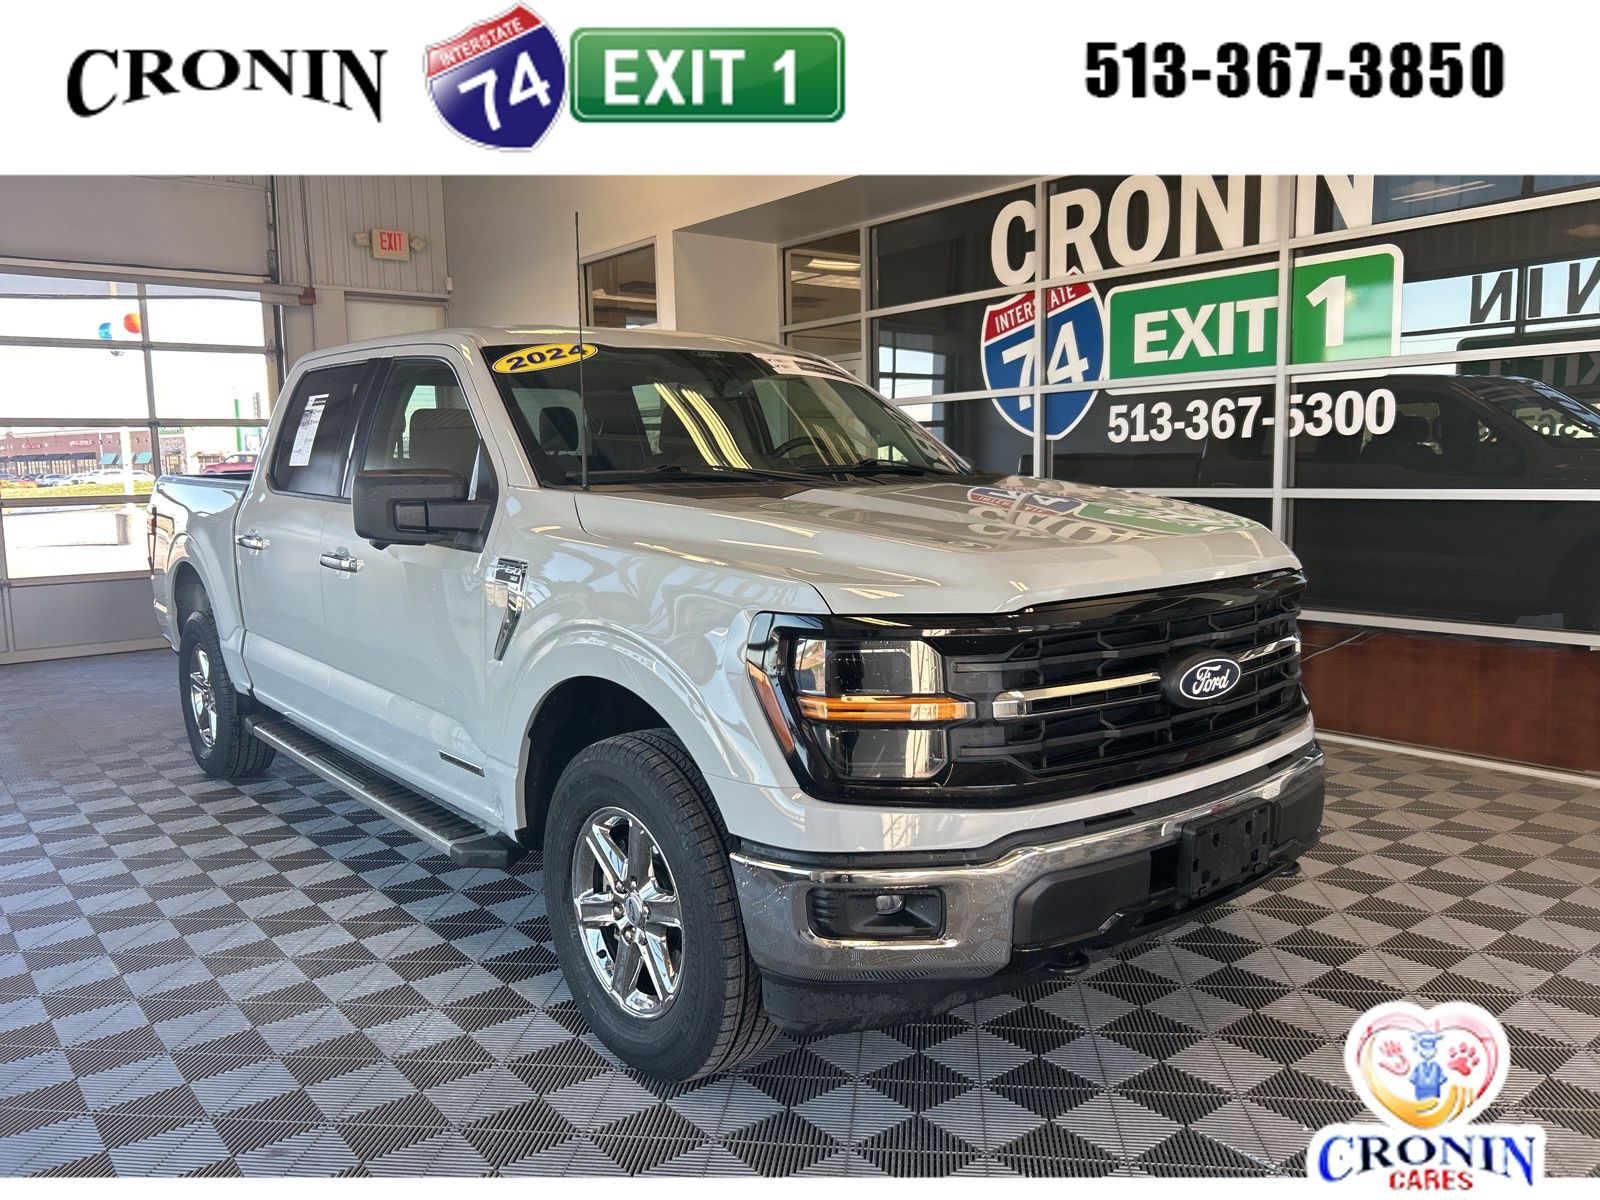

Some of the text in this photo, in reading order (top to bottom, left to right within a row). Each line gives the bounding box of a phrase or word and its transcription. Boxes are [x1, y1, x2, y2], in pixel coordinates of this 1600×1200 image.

[380, 231, 404, 252] EXIT
[991, 175, 1374, 287] CRONIN
[994, 285, 1077, 334] INTERATE
[1133, 275, 1346, 364] EXIT 1
[506, 344, 588, 371] 2024
[1001, 320, 1089, 411] 74
[1107, 388, 1396, 443] 513-367-5300
[1192, 665, 1230, 695] Ford
